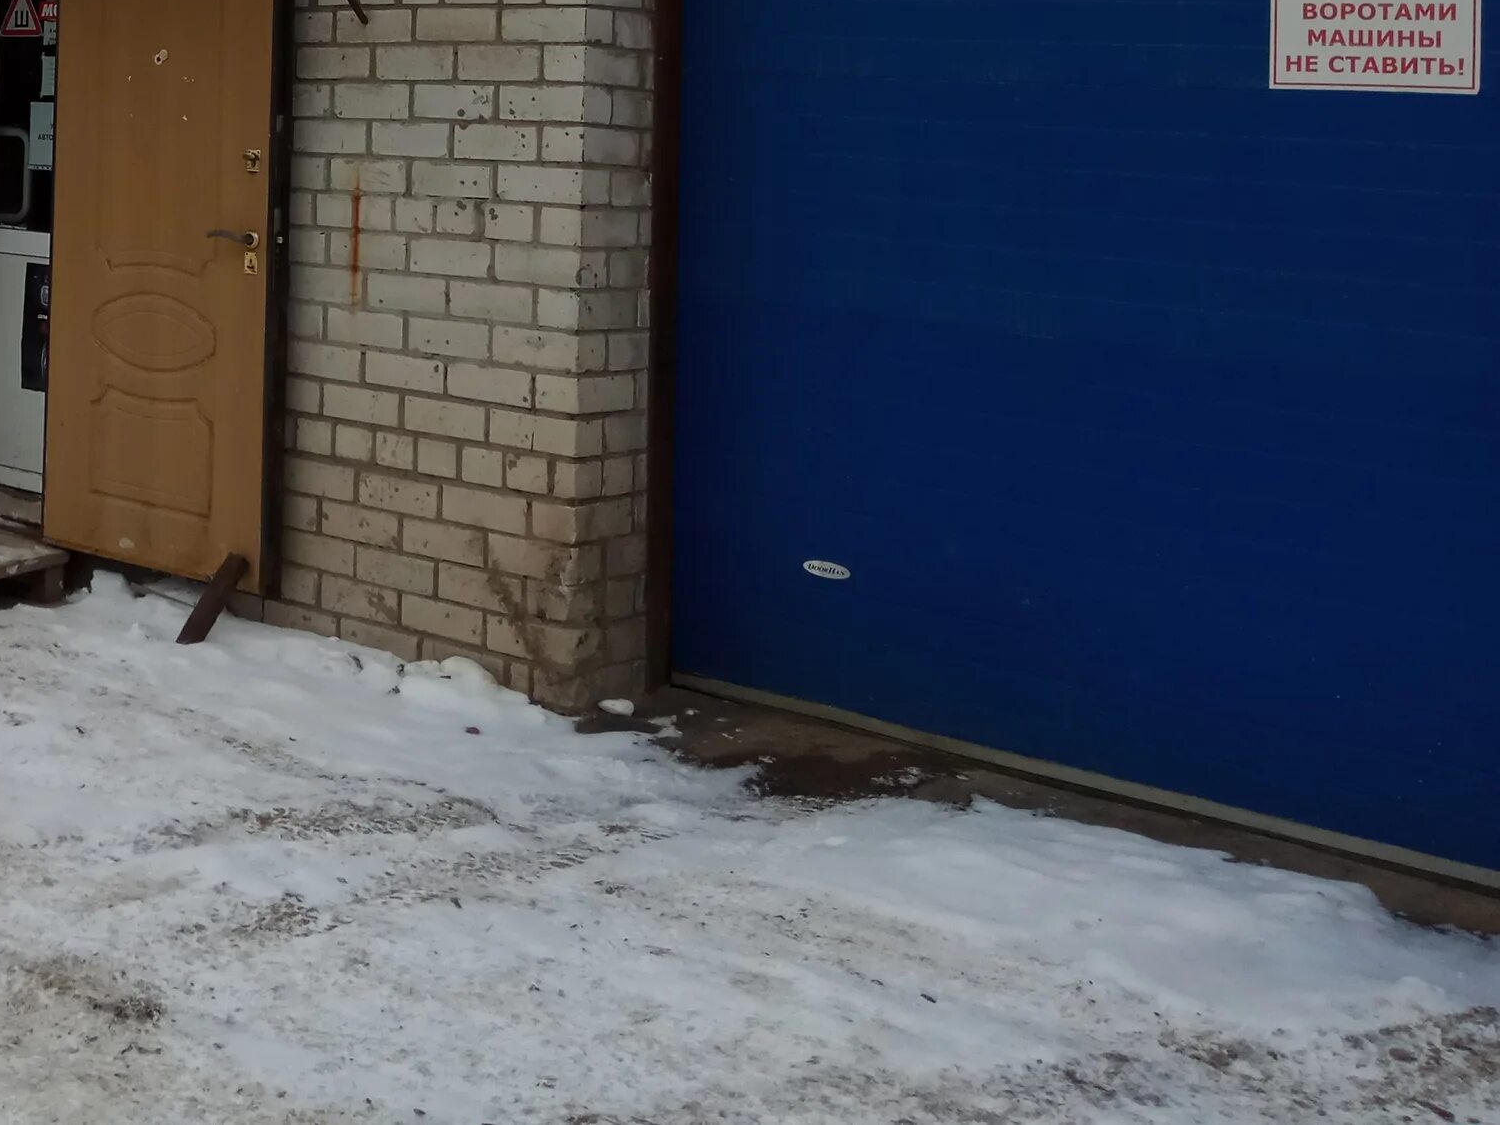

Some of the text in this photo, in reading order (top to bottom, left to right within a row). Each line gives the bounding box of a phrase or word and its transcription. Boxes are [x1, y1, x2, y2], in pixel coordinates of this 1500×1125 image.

[1301, 1, 1458, 22] ВОРОТАМИ
[1306, 28, 1443, 49] МАШИНЫ
[1285, 55, 1466, 77] НЕ СТАВИТЬ!
